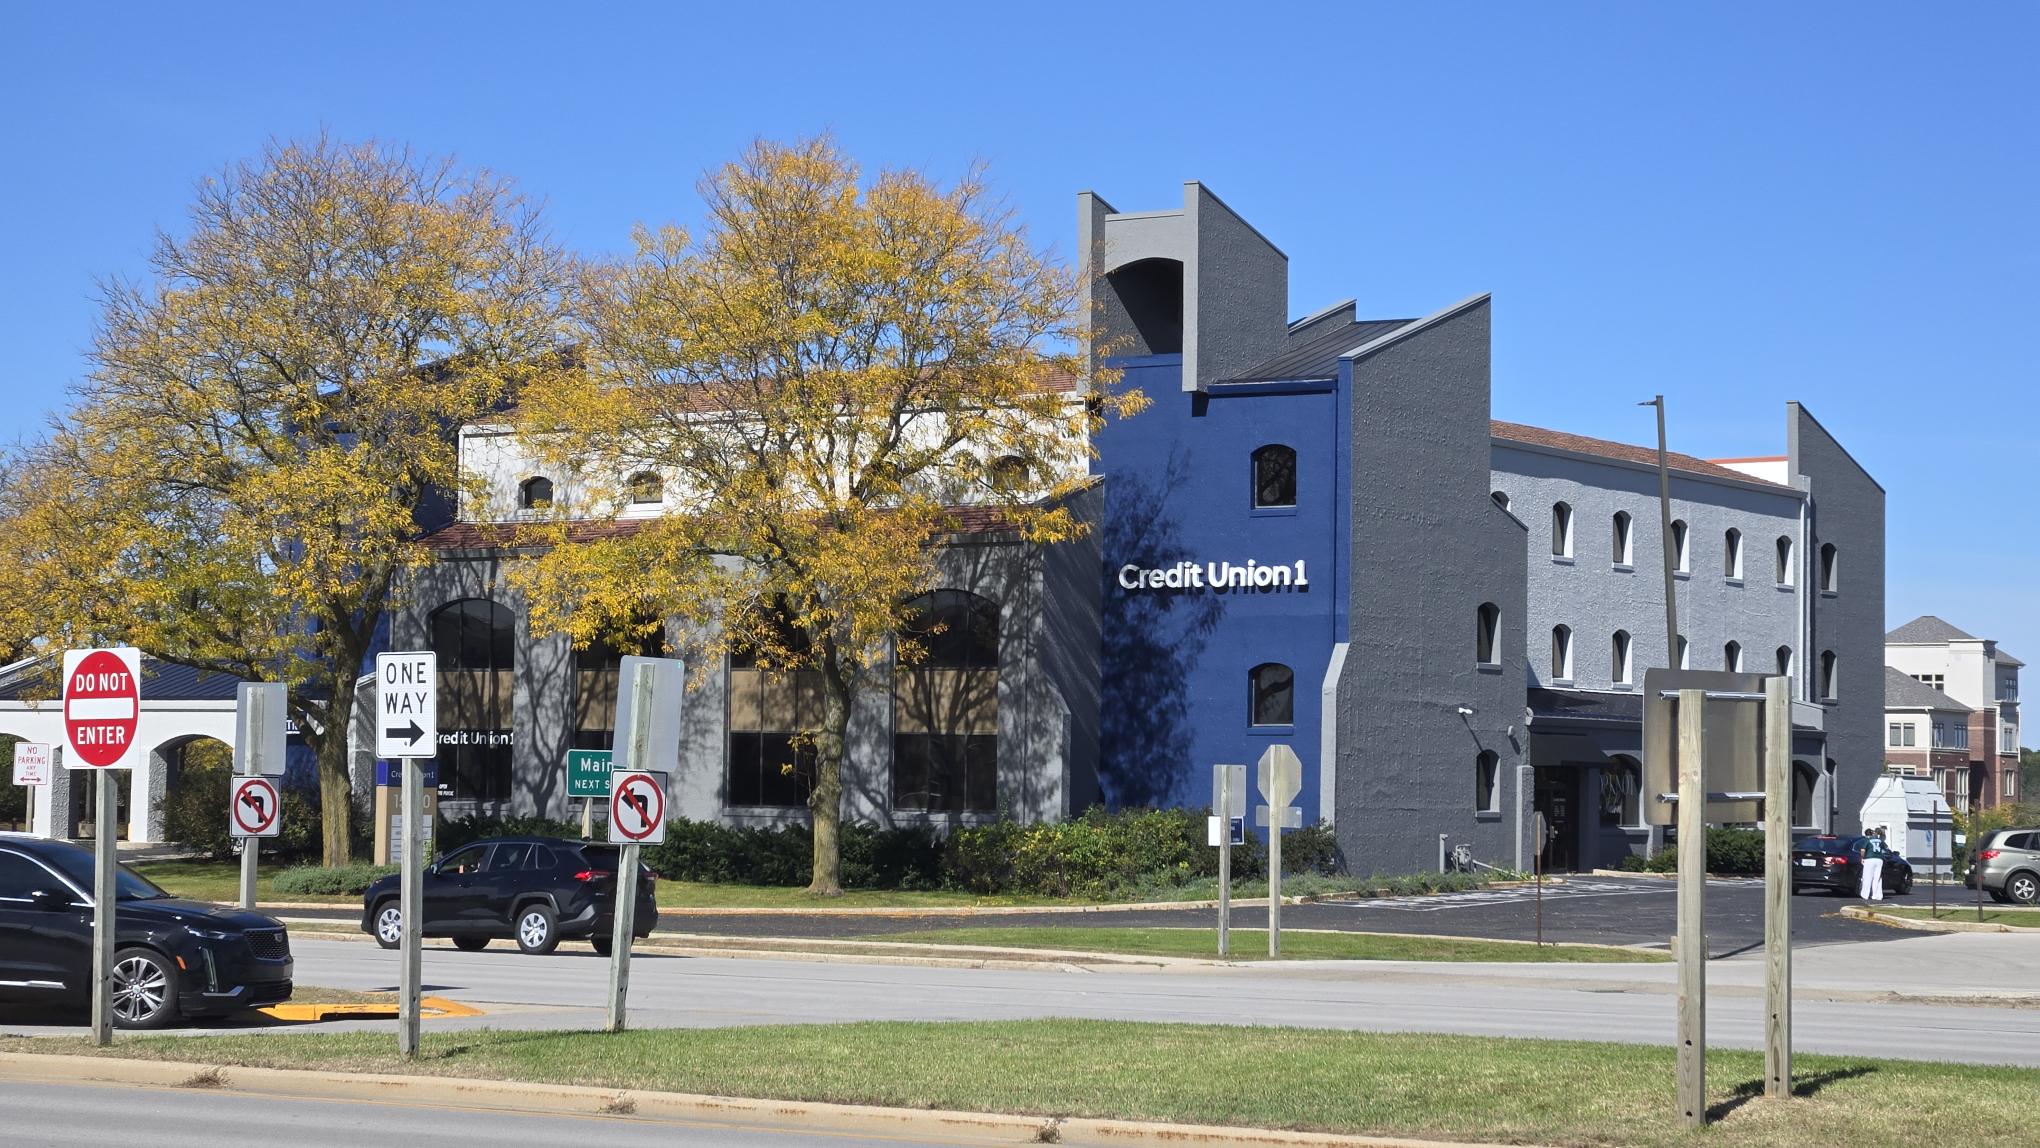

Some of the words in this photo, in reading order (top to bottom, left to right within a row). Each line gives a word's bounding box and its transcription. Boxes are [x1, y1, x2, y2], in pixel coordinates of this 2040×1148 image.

[1118, 562, 1204, 589] Credit
[75, 674, 95, 692] DO
[99, 673, 128, 691] NOT
[386, 662, 426, 684] ONE
[385, 692, 427, 714] WAY
[77, 726, 125, 745] ENTER
[27, 746, 38, 754] NO
[17, 755, 46, 765] PARKING
[574, 779, 600, 789] NEXT
